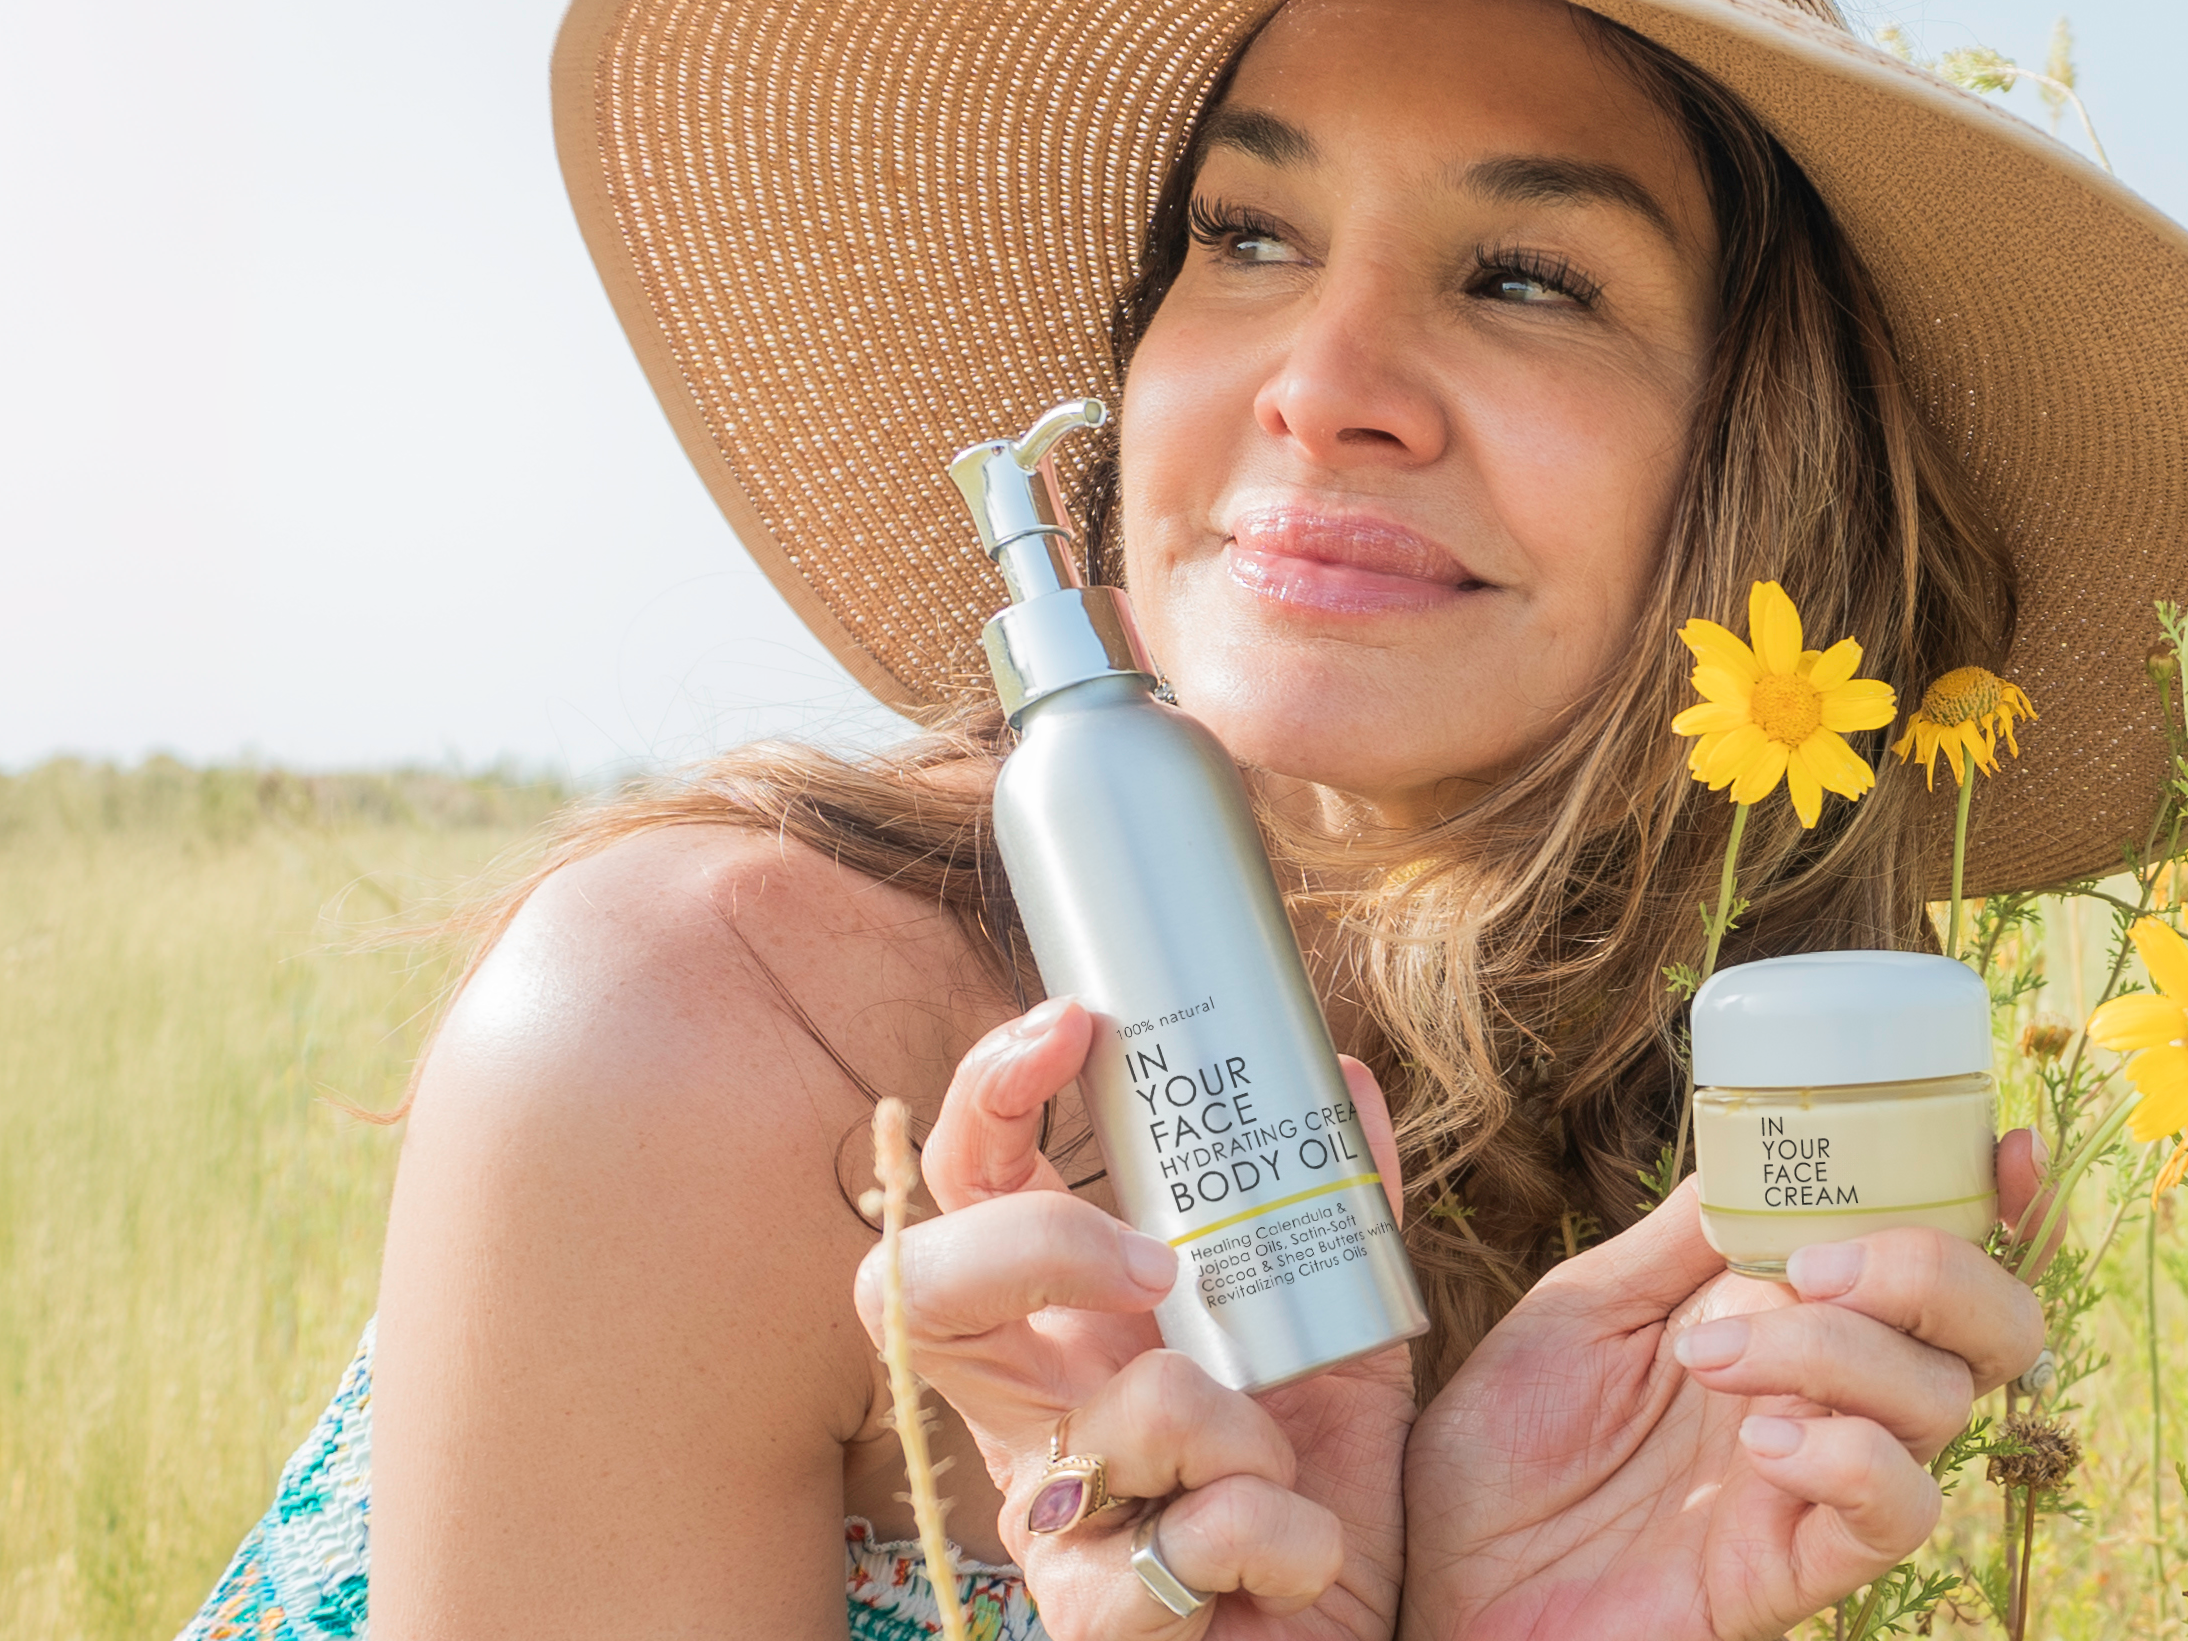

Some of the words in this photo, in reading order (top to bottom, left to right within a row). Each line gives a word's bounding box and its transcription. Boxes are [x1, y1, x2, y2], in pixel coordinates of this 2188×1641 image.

[1116, 1019, 1154, 1040] 100%
[1159, 996, 1216, 1027] natural
[1125, 1043, 1169, 1083] IN
[1135, 1056, 1251, 1116] YOUR
[1149, 1092, 1257, 1153] FACE
[1160, 1119, 1298, 1179] HYDRATING
[1761, 1116, 1784, 1137] IN
[1762, 1138, 1831, 1161] YOUR
[1170, 1150, 1281, 1213] BODY
[1299, 1131, 1358, 1170] OIL
[1763, 1161, 1828, 1184] FACE
[1764, 1185, 1859, 1207] CREAM
[1190, 1233, 1252, 1262] Healing
[1255, 1206, 1333, 1240] Calendula
[1336, 1202, 1347, 1214] &
[1198, 1251, 1251, 1278] Jojoba
[1255, 1240, 1288, 1257] Oils,
[1290, 1214, 1357, 1246] Satin-Soft
[1201, 1267, 1257, 1292] Cocoa
[1262, 1260, 1274, 1273] &
[1277, 1247, 1315, 1268] Shea
[1319, 1231, 1366, 1254] Butters
[1367, 1220, 1394, 1237] with
[1206, 1271, 1295, 1309] Revitalizing
[1298, 1257, 1340, 1278] Citrus
[1342, 1246, 1368, 1262] Oils
